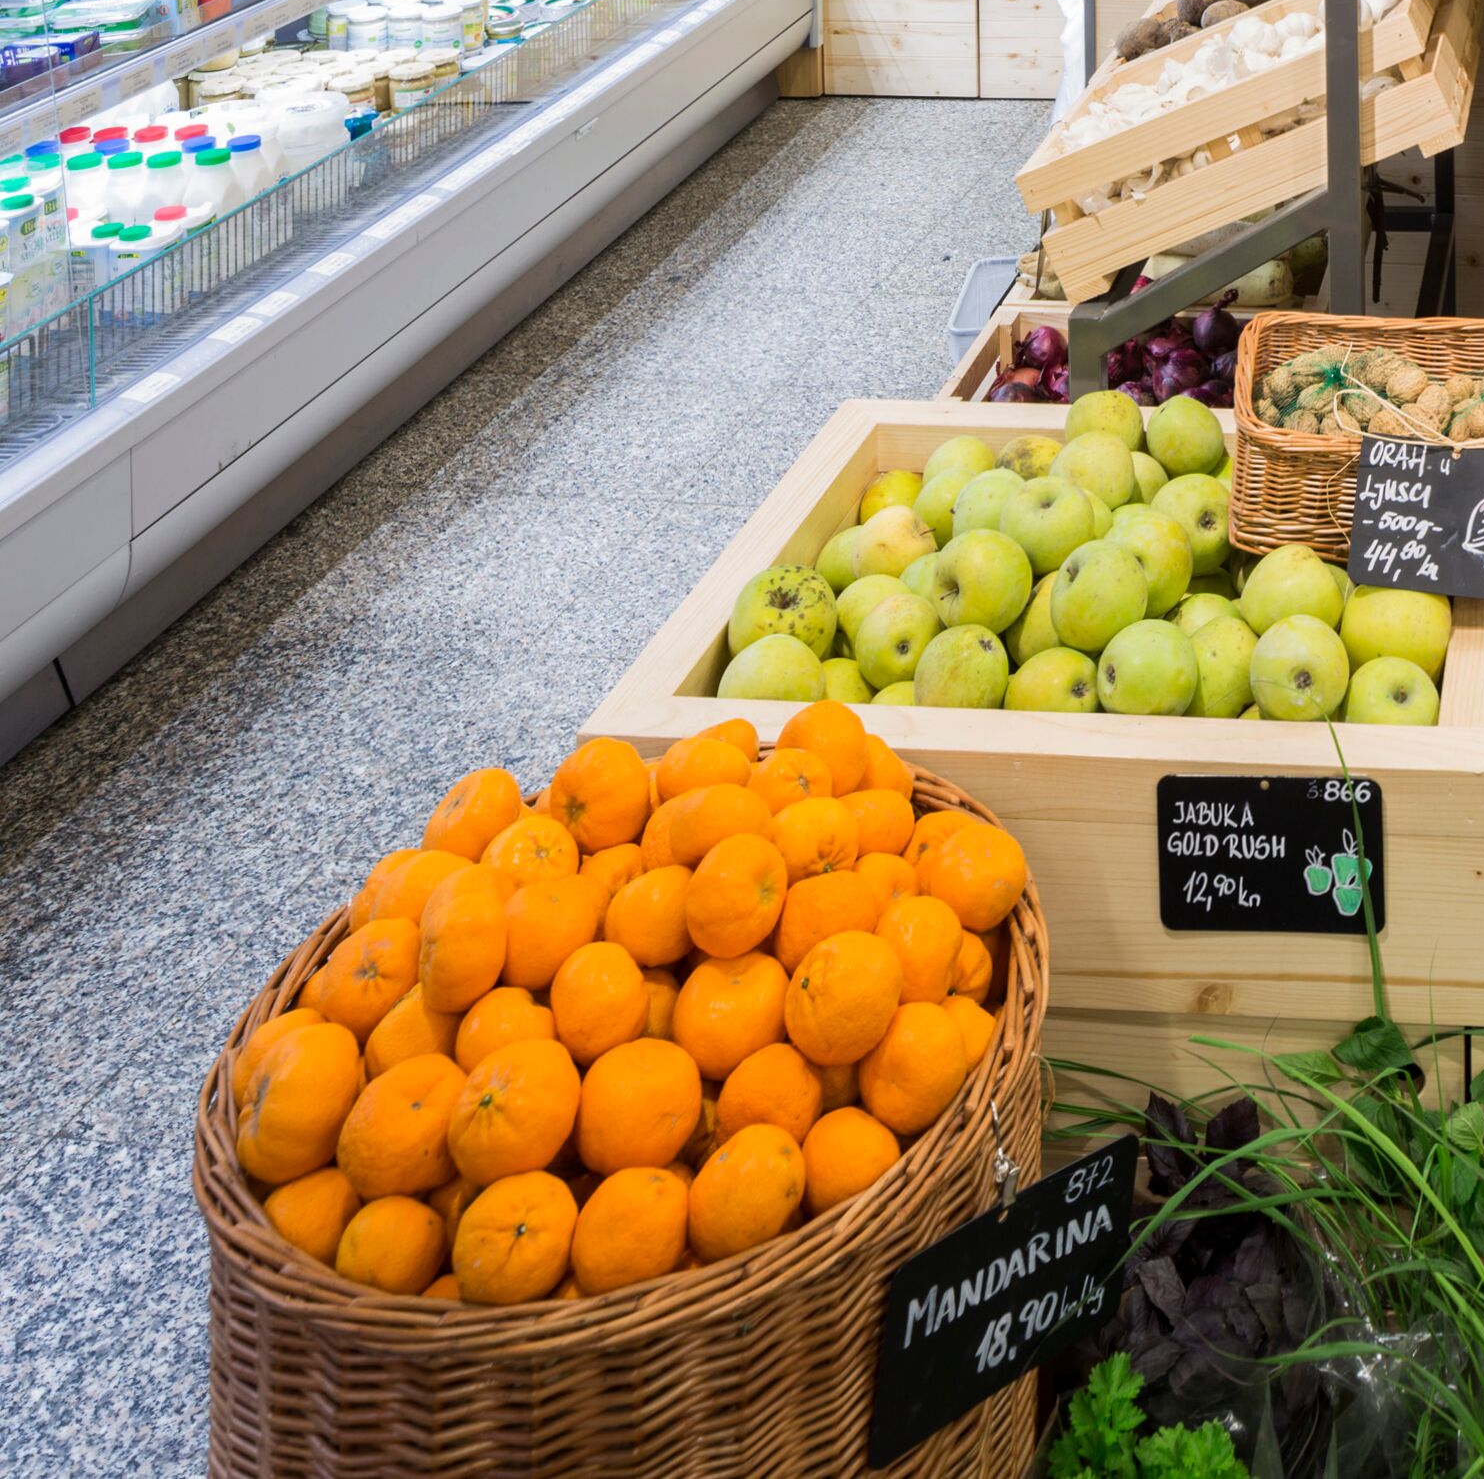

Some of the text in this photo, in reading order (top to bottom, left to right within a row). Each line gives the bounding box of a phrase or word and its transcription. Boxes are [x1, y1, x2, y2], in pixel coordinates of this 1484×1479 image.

[1172, 801, 1254, 828] JABUKA
[1167, 830, 1286, 860] GOLD RUSH
[1064, 1154, 1115, 1204] 872
[903, 1203, 1114, 1350] MANDARINA
